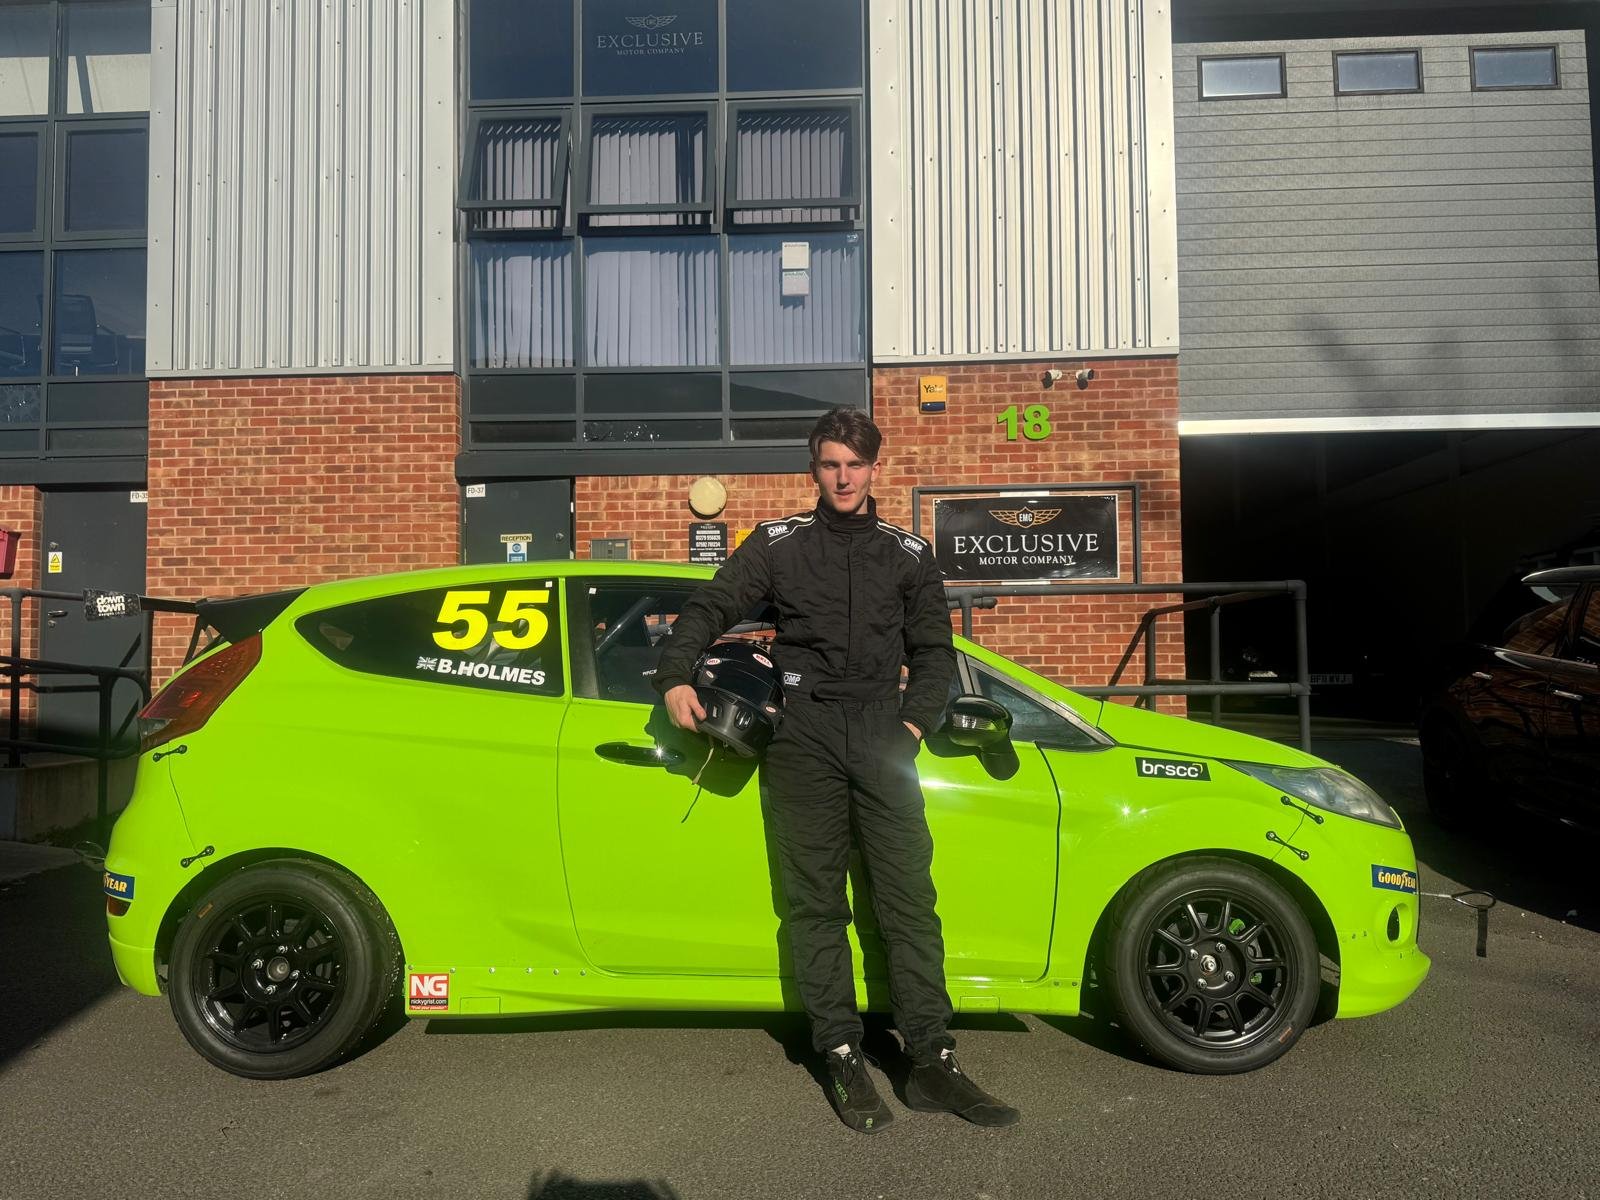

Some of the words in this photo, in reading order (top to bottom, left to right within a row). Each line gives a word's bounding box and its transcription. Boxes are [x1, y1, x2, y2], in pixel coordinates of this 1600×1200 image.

[597, 32, 704, 48] EXCLUSIVE
[647, 47, 686, 55] COMPANY
[996, 404, 1052, 442] 18
[1019, 513, 1033, 522] EMC
[768, 525, 788, 536] OMP
[904, 538, 923, 551] OMP
[953, 533, 1100, 554] EXCLUSIVE
[979, 556, 1018, 566] MOTOR
[1022, 555, 1074, 565] COMPANY
[97, 595, 125, 605] down
[97, 602, 126, 613] town
[432, 589, 550, 651] 55
[437, 658, 546, 686] B.HOLMES
[784, 674, 801, 685] OMP
[1142, 760, 1199, 778] brscc
[411, 975, 448, 997] NG
